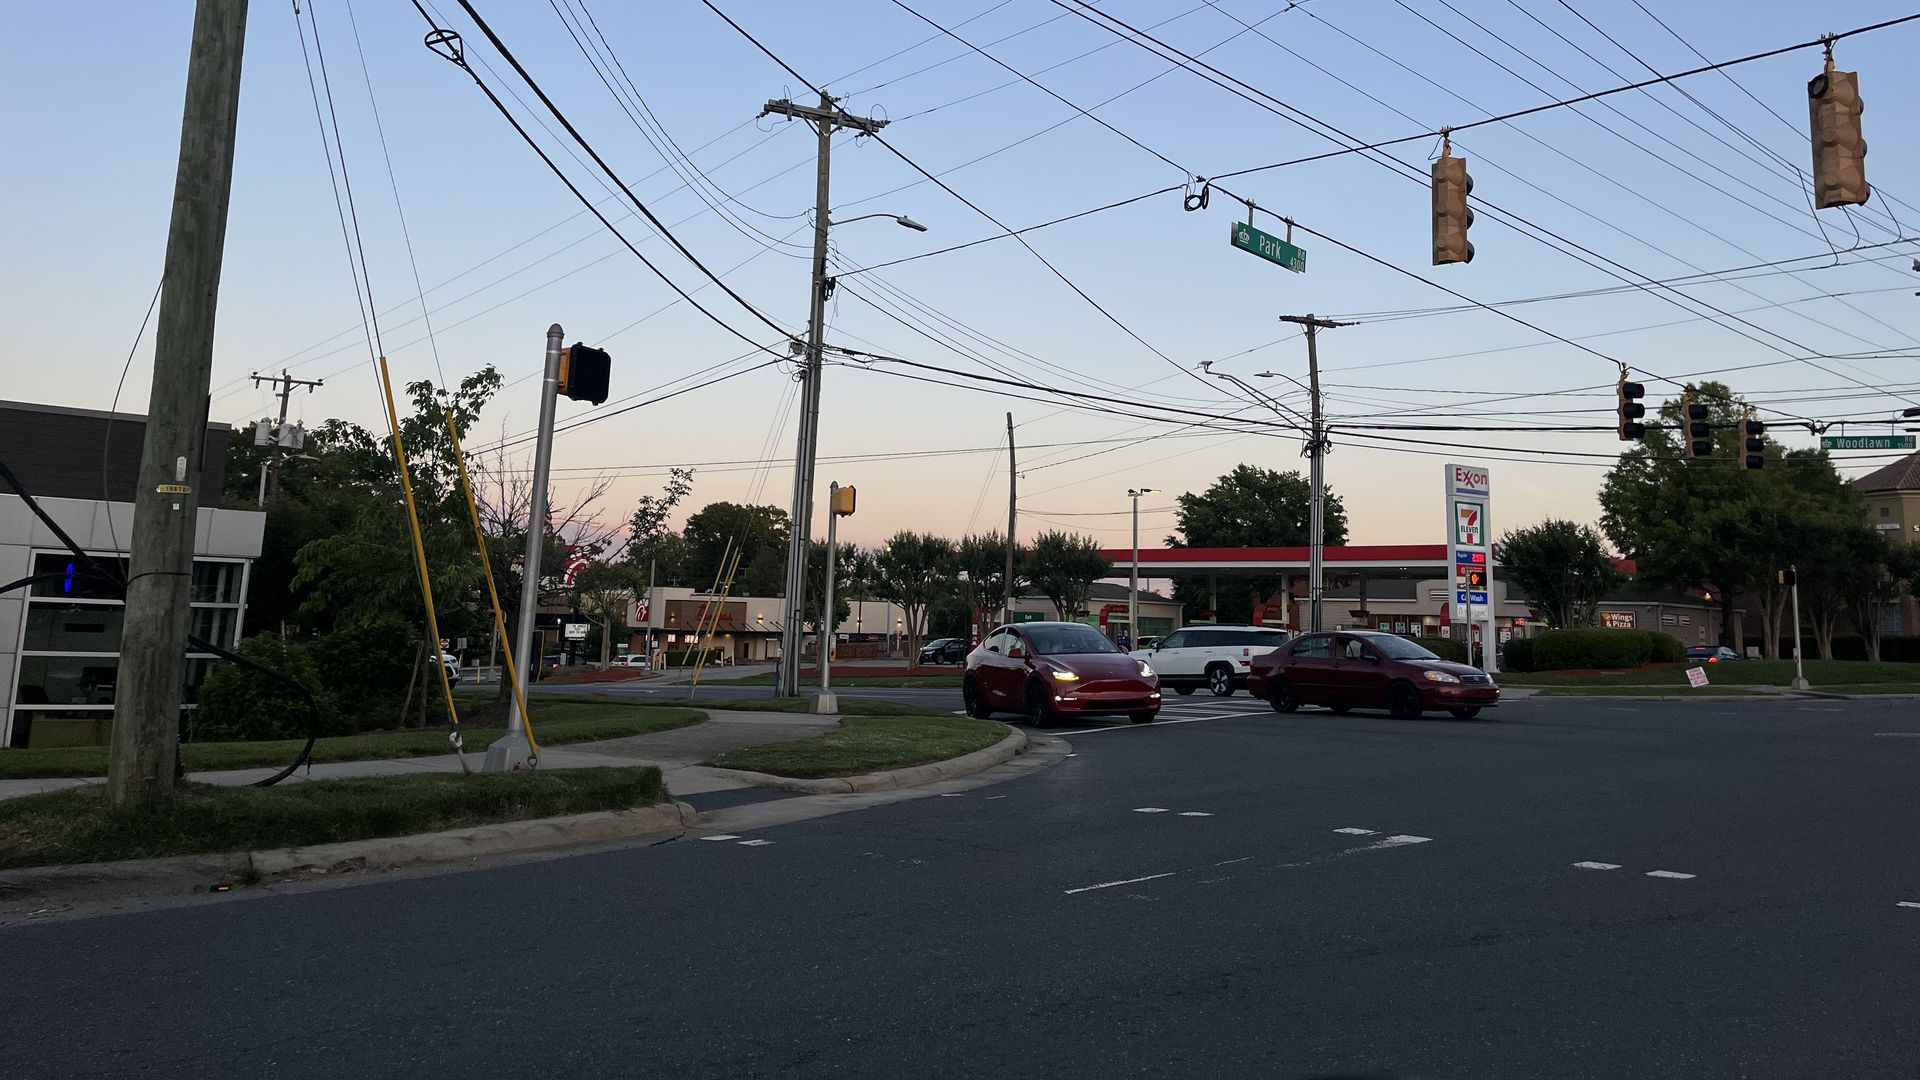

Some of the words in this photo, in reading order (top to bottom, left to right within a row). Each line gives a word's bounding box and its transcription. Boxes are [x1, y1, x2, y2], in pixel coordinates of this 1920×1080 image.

[1259, 235, 1281, 259] Park
[1297, 248, 1306, 261] Rd
[1289, 257, 1305, 272] 4300
[1836, 437, 1890, 448] Woodlawn
[1455, 467, 1488, 488] Exxon
[1470, 594, 1484, 602] Wash
[1610, 613, 1633, 622] Wings
[1606, 620, 1612, 628] &
[1612, 620, 1632, 628] Pizza
